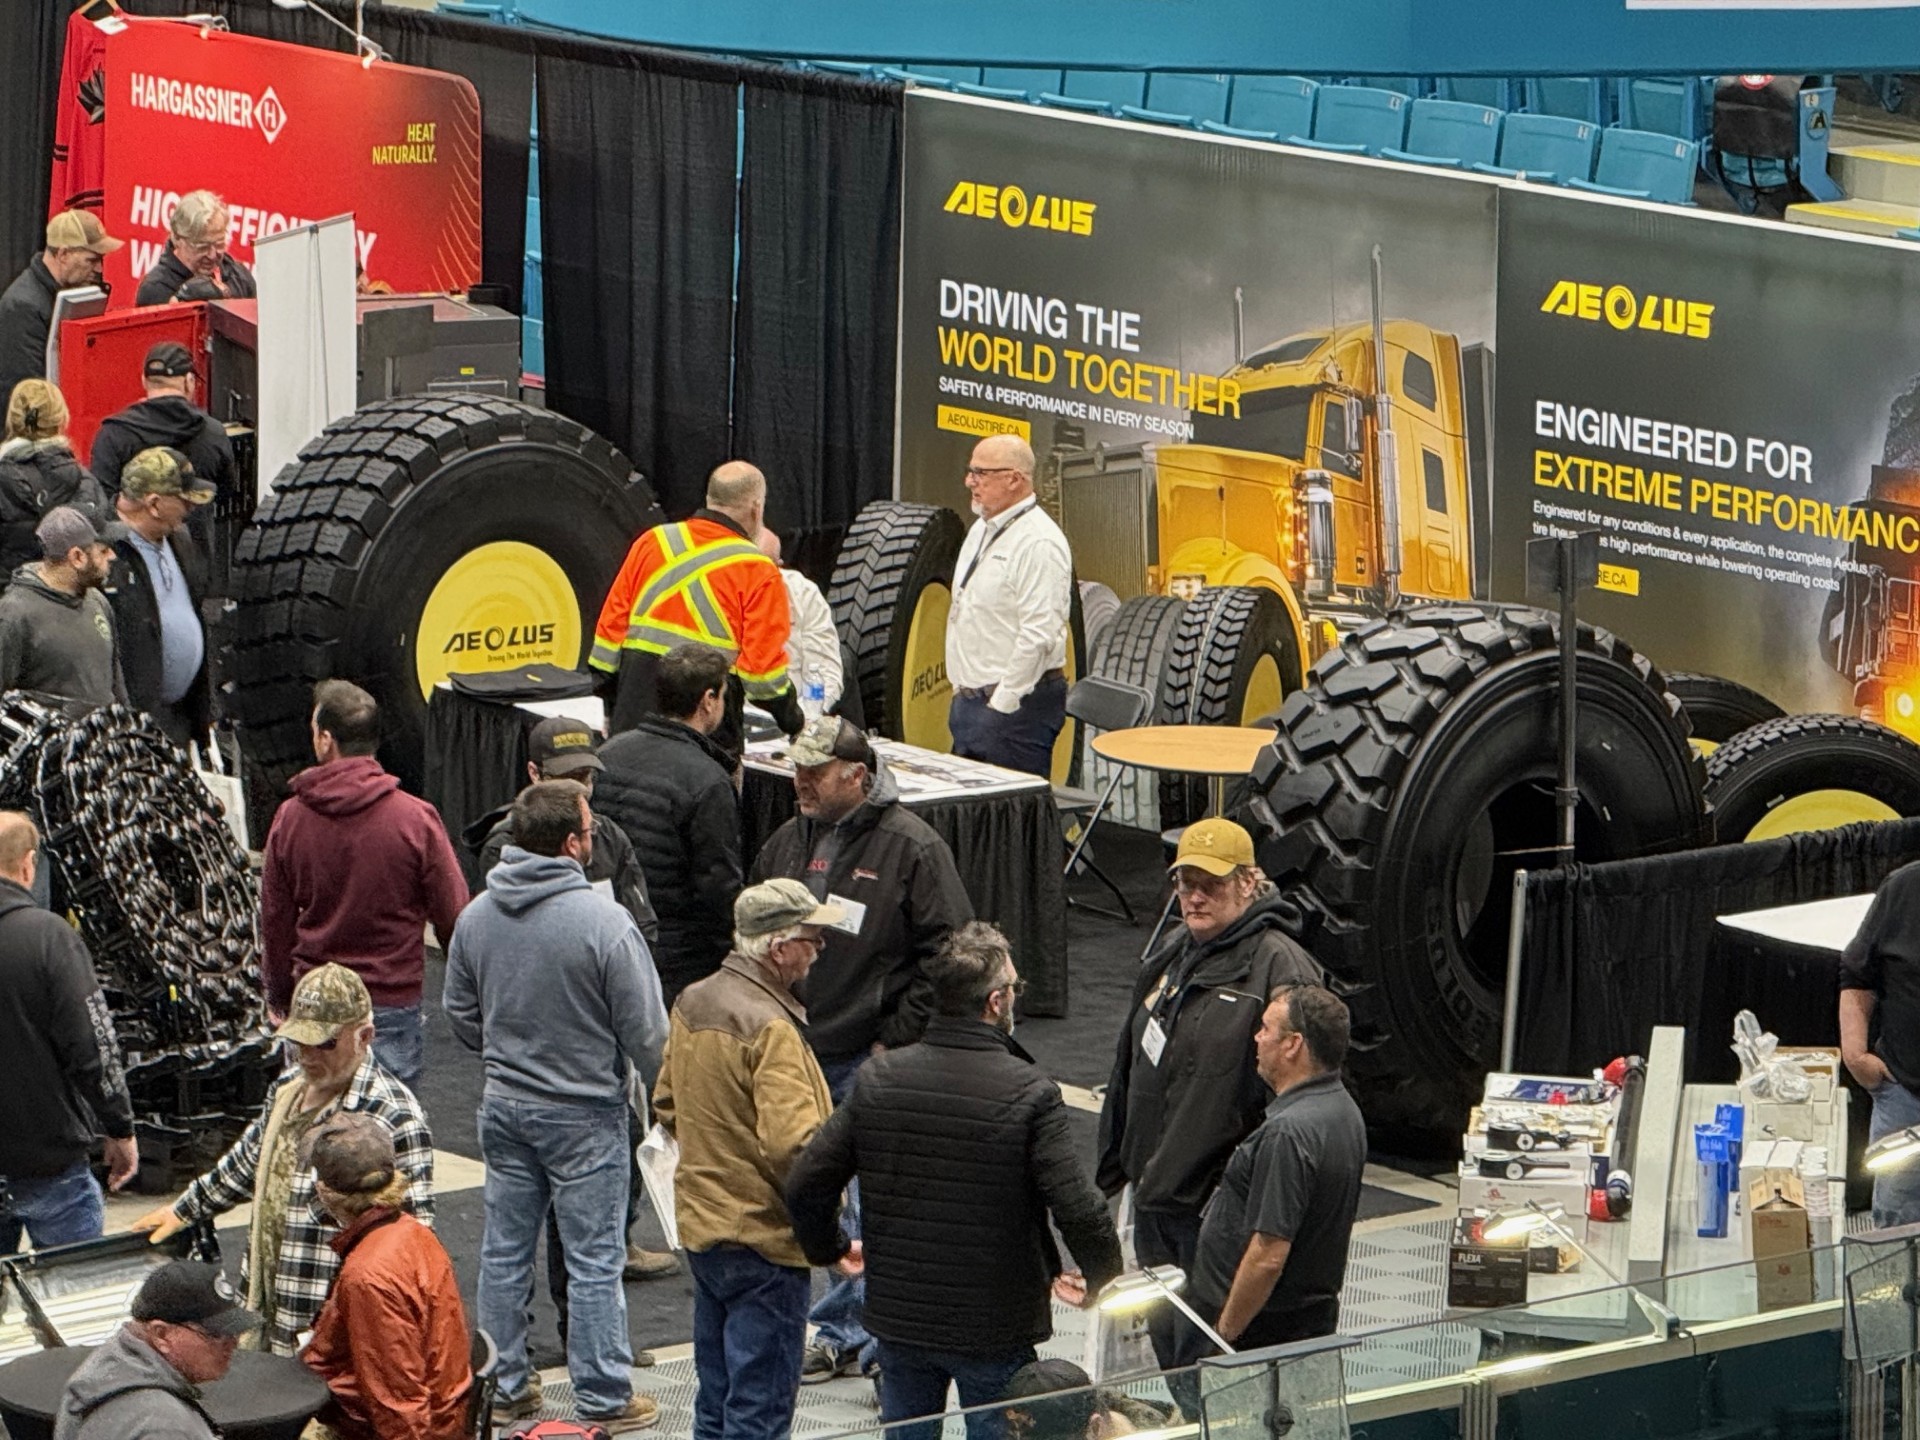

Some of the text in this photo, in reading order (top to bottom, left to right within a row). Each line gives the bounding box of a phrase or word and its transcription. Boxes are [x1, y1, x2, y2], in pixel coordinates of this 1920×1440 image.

[131, 72, 253, 129] HARGASSNER
[372, 144, 437, 165] NATURALLY.
[408, 122, 437, 142] HEAT
[130, 185, 182, 231] HIG
[943, 181, 1097, 236] AEOLUS
[940, 279, 1141, 352] DRIVING THE
[1540, 280, 1715, 339] AEOLUS
[938, 326, 1241, 419] WORLD TOGETHER
[939, 376, 1194, 439] SAFETY & PERFORMANCE IN EVERY SEASON
[1535, 400, 1813, 483] ENGINEERED FOR
[1532, 521, 1548, 536] tire
[1534, 450, 1920, 554] EXTREME PERFORMANC
[1533, 499, 1586, 523] Engineered
[1587, 510, 1602, 524] for
[1602, 515, 1621, 531] any
[1622, 518, 1671, 539] conditions
[1672, 526, 1681, 539] &
[1683, 530, 1709, 548] every
[1710, 536, 1766, 558] application,
[1768, 544, 1785, 559] the
[1786, 549, 1832, 568] complete
[1609, 535, 1631, 553] high
[1632, 542, 1693, 564] performance
[1694, 554, 1720, 569] while
[1721, 557, 1763, 580] lowering
[1764, 567, 1811, 589] operating
[1812, 575, 1840, 592] costs
[442, 623, 556, 654] AEOLUS
[911, 662, 947, 701] AEOLU
